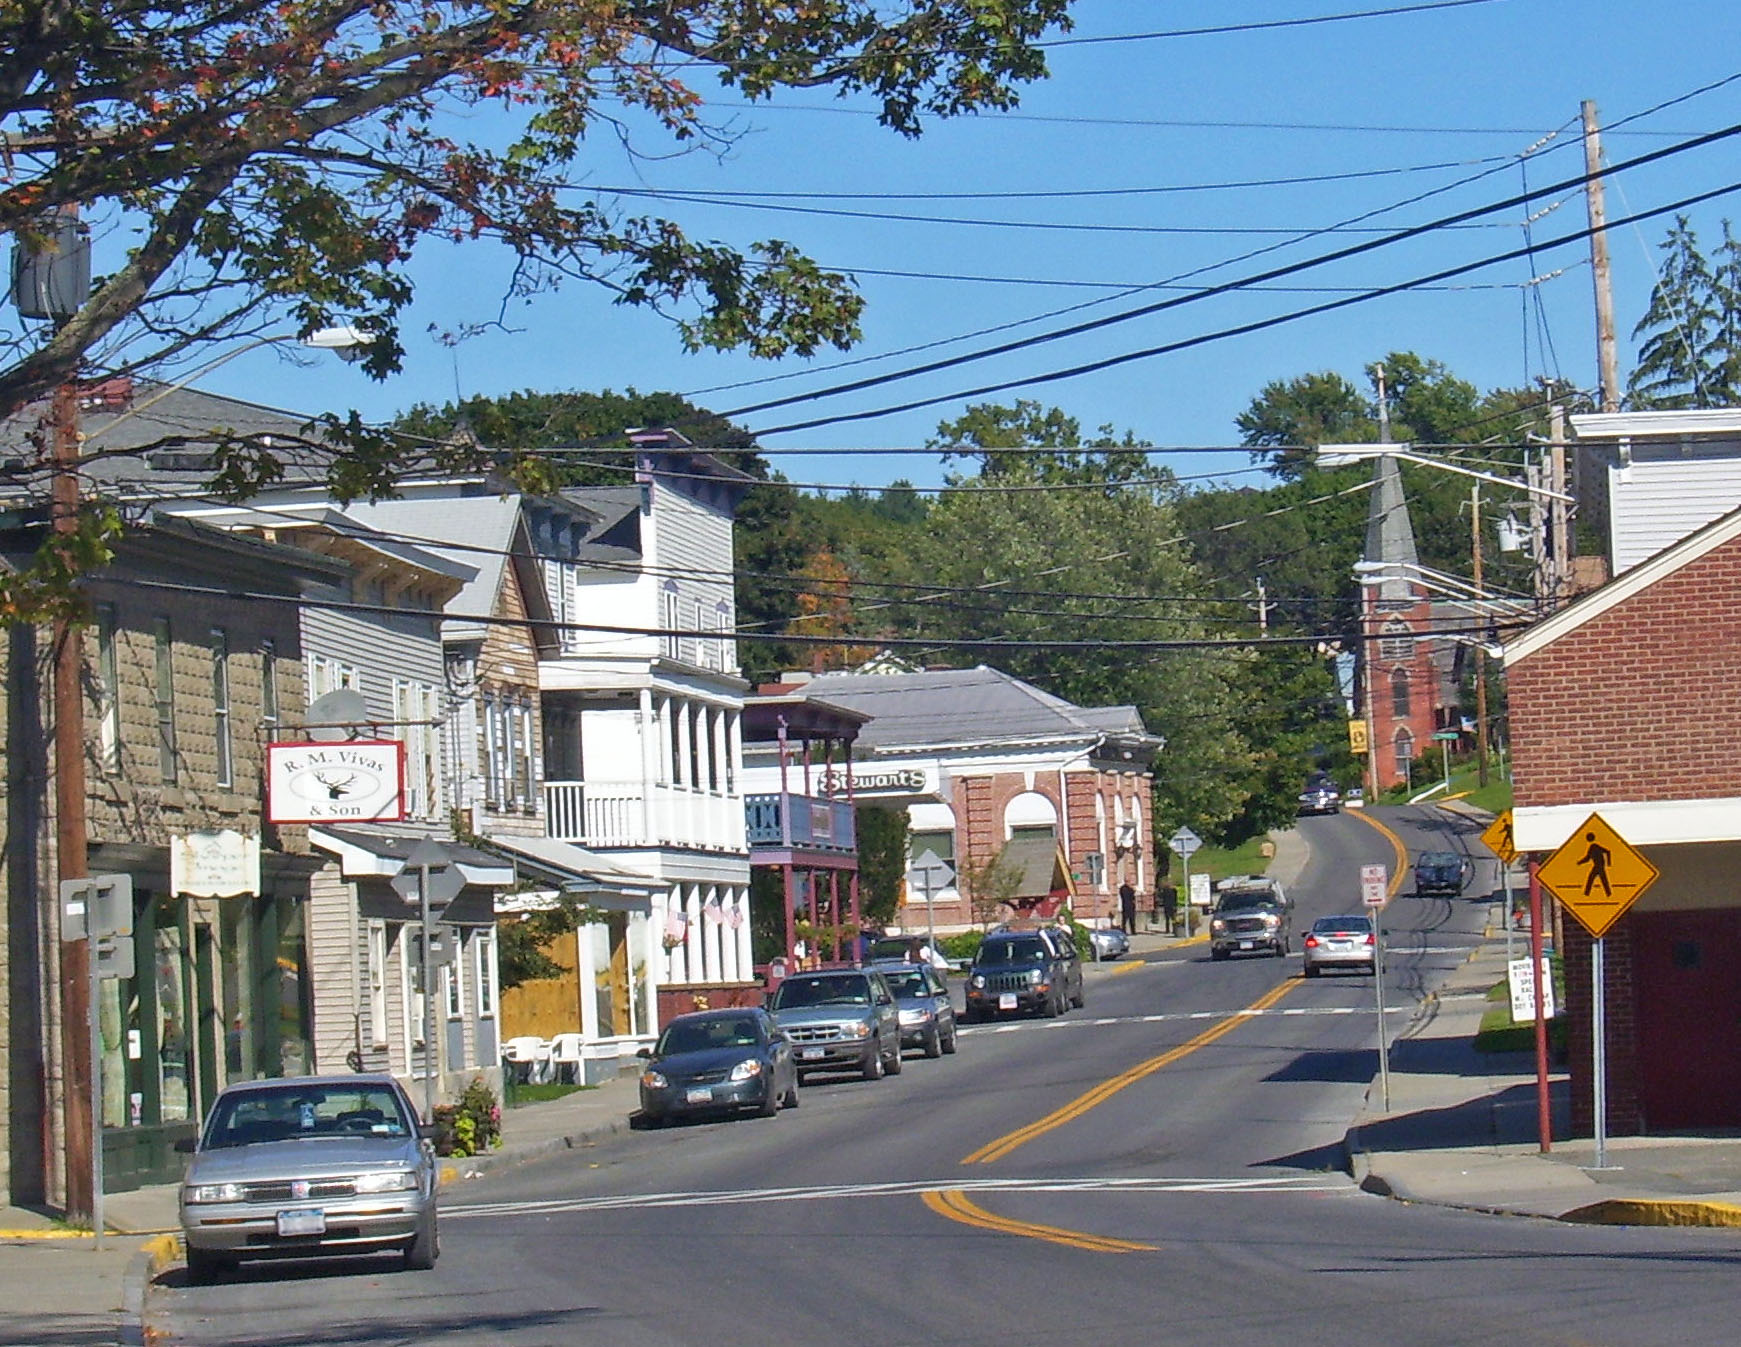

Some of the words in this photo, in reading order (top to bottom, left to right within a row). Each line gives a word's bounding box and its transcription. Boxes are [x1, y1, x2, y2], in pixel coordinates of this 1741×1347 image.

[284, 760, 304, 773] R.
[308, 751, 332, 765] M.
[339, 750, 384, 772] Vivas
[309, 804, 322, 816] &
[328, 803, 361, 815] Son
